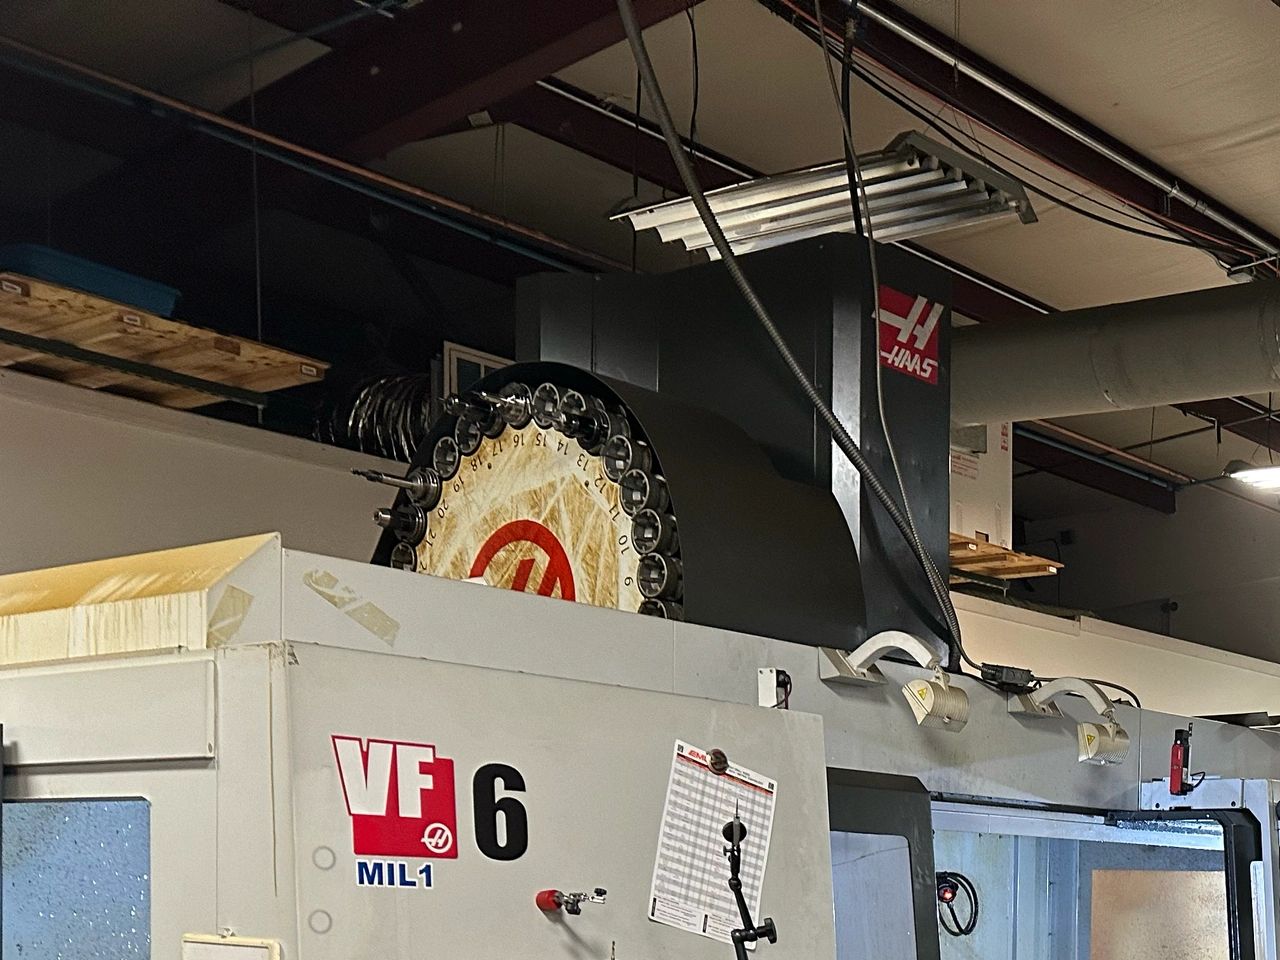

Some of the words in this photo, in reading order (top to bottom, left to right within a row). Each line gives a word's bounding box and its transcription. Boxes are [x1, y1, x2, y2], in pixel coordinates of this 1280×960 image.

[880, 345, 938, 378] HAAS
[492, 440, 503, 456] 17
[513, 435, 525, 447] 16
[535, 435, 547, 447] 15
[557, 442, 569, 456] 14
[471, 454, 484, 472] 18
[576, 453, 589, 471] 13
[593, 475, 610, 494] 12
[618, 534, 629, 554] 10
[331, 735, 435, 818] VF
[473, 763, 528, 862] 6
[357, 861, 433, 887] MIL1
